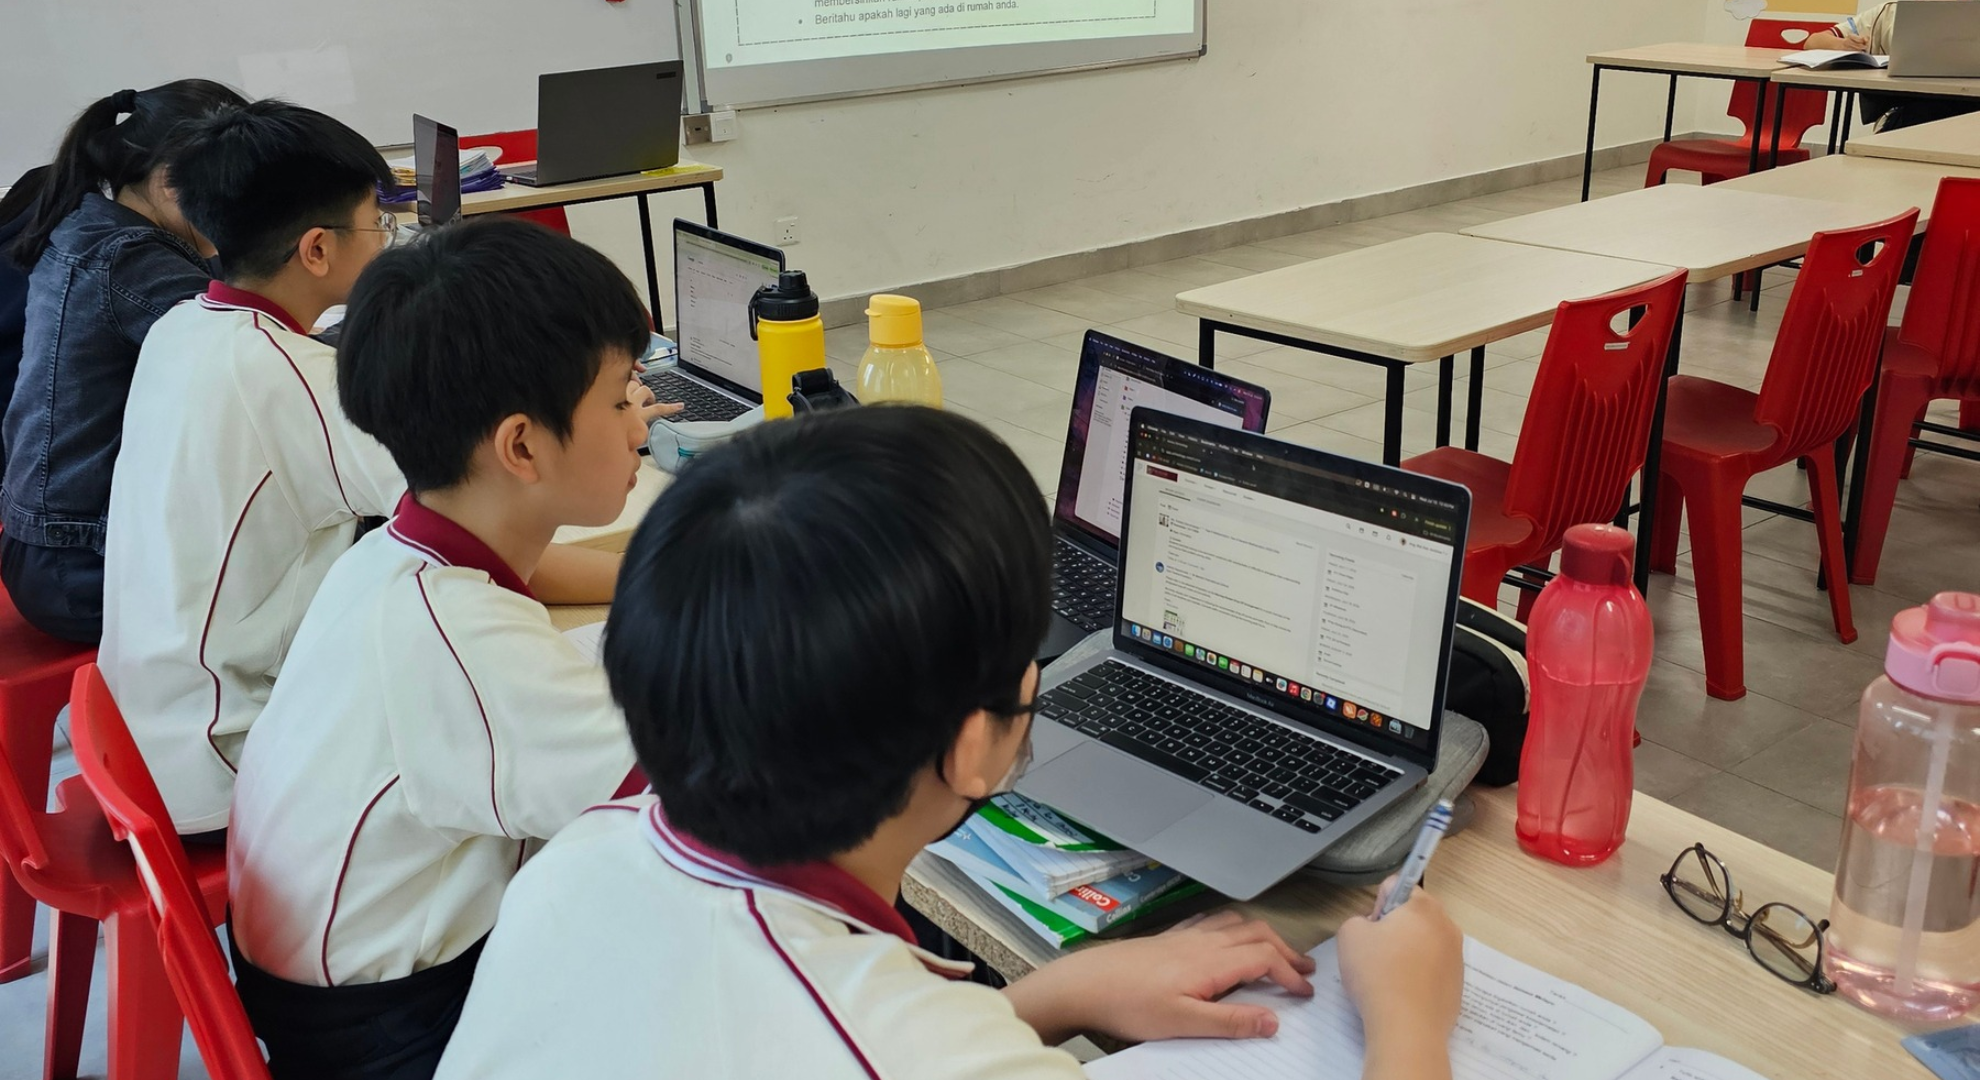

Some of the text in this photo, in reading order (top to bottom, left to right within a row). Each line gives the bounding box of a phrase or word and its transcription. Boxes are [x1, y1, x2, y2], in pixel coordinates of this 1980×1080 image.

[815, 0, 1020, 25] Beritahu apakah lagi yang ada di rumah anda.
[1106, 904, 1132, 924] Collins
